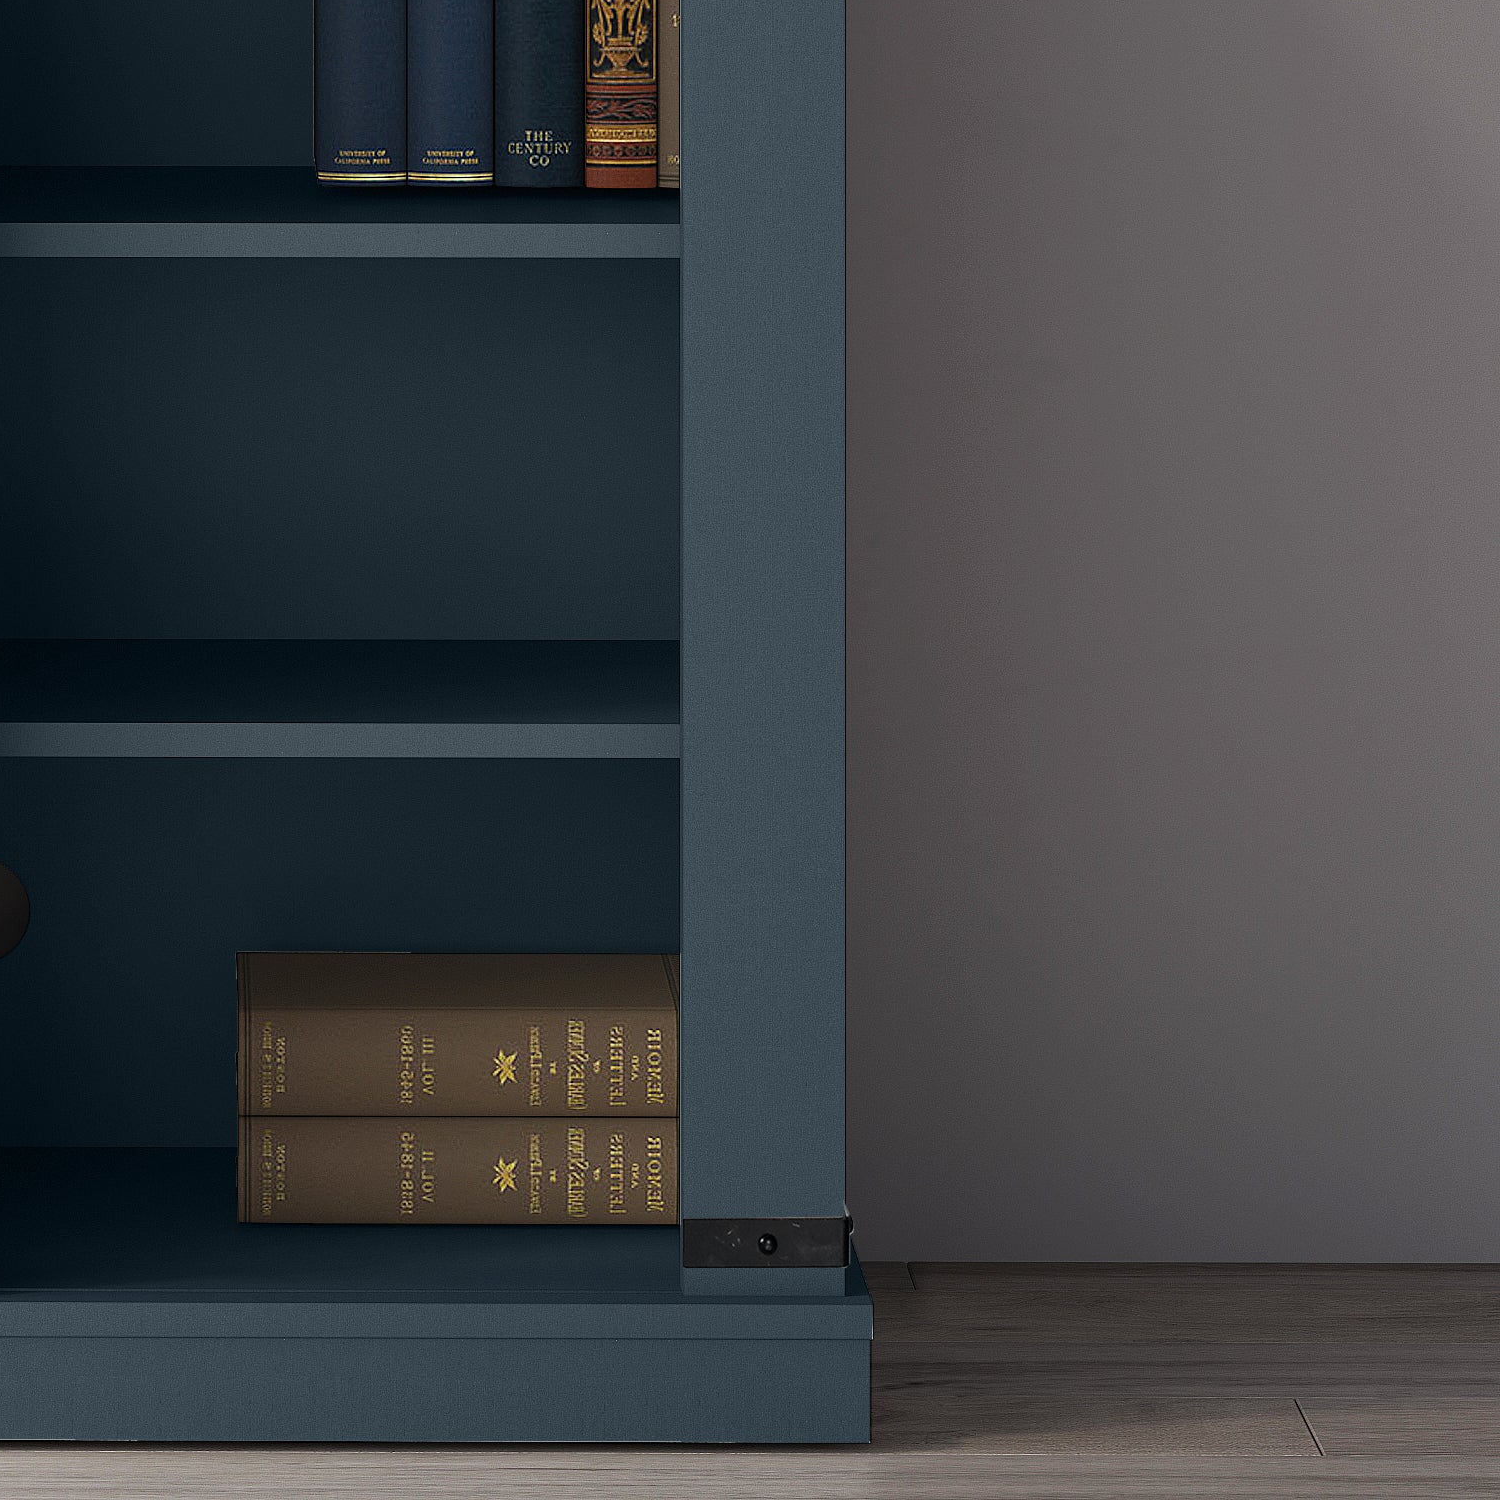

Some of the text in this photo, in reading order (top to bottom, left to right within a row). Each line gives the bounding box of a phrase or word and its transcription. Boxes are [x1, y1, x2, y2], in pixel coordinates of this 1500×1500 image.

[525, 130, 554, 142] THE
[508, 141, 572, 155] CENTURY
[529, 155, 550, 167] CO
